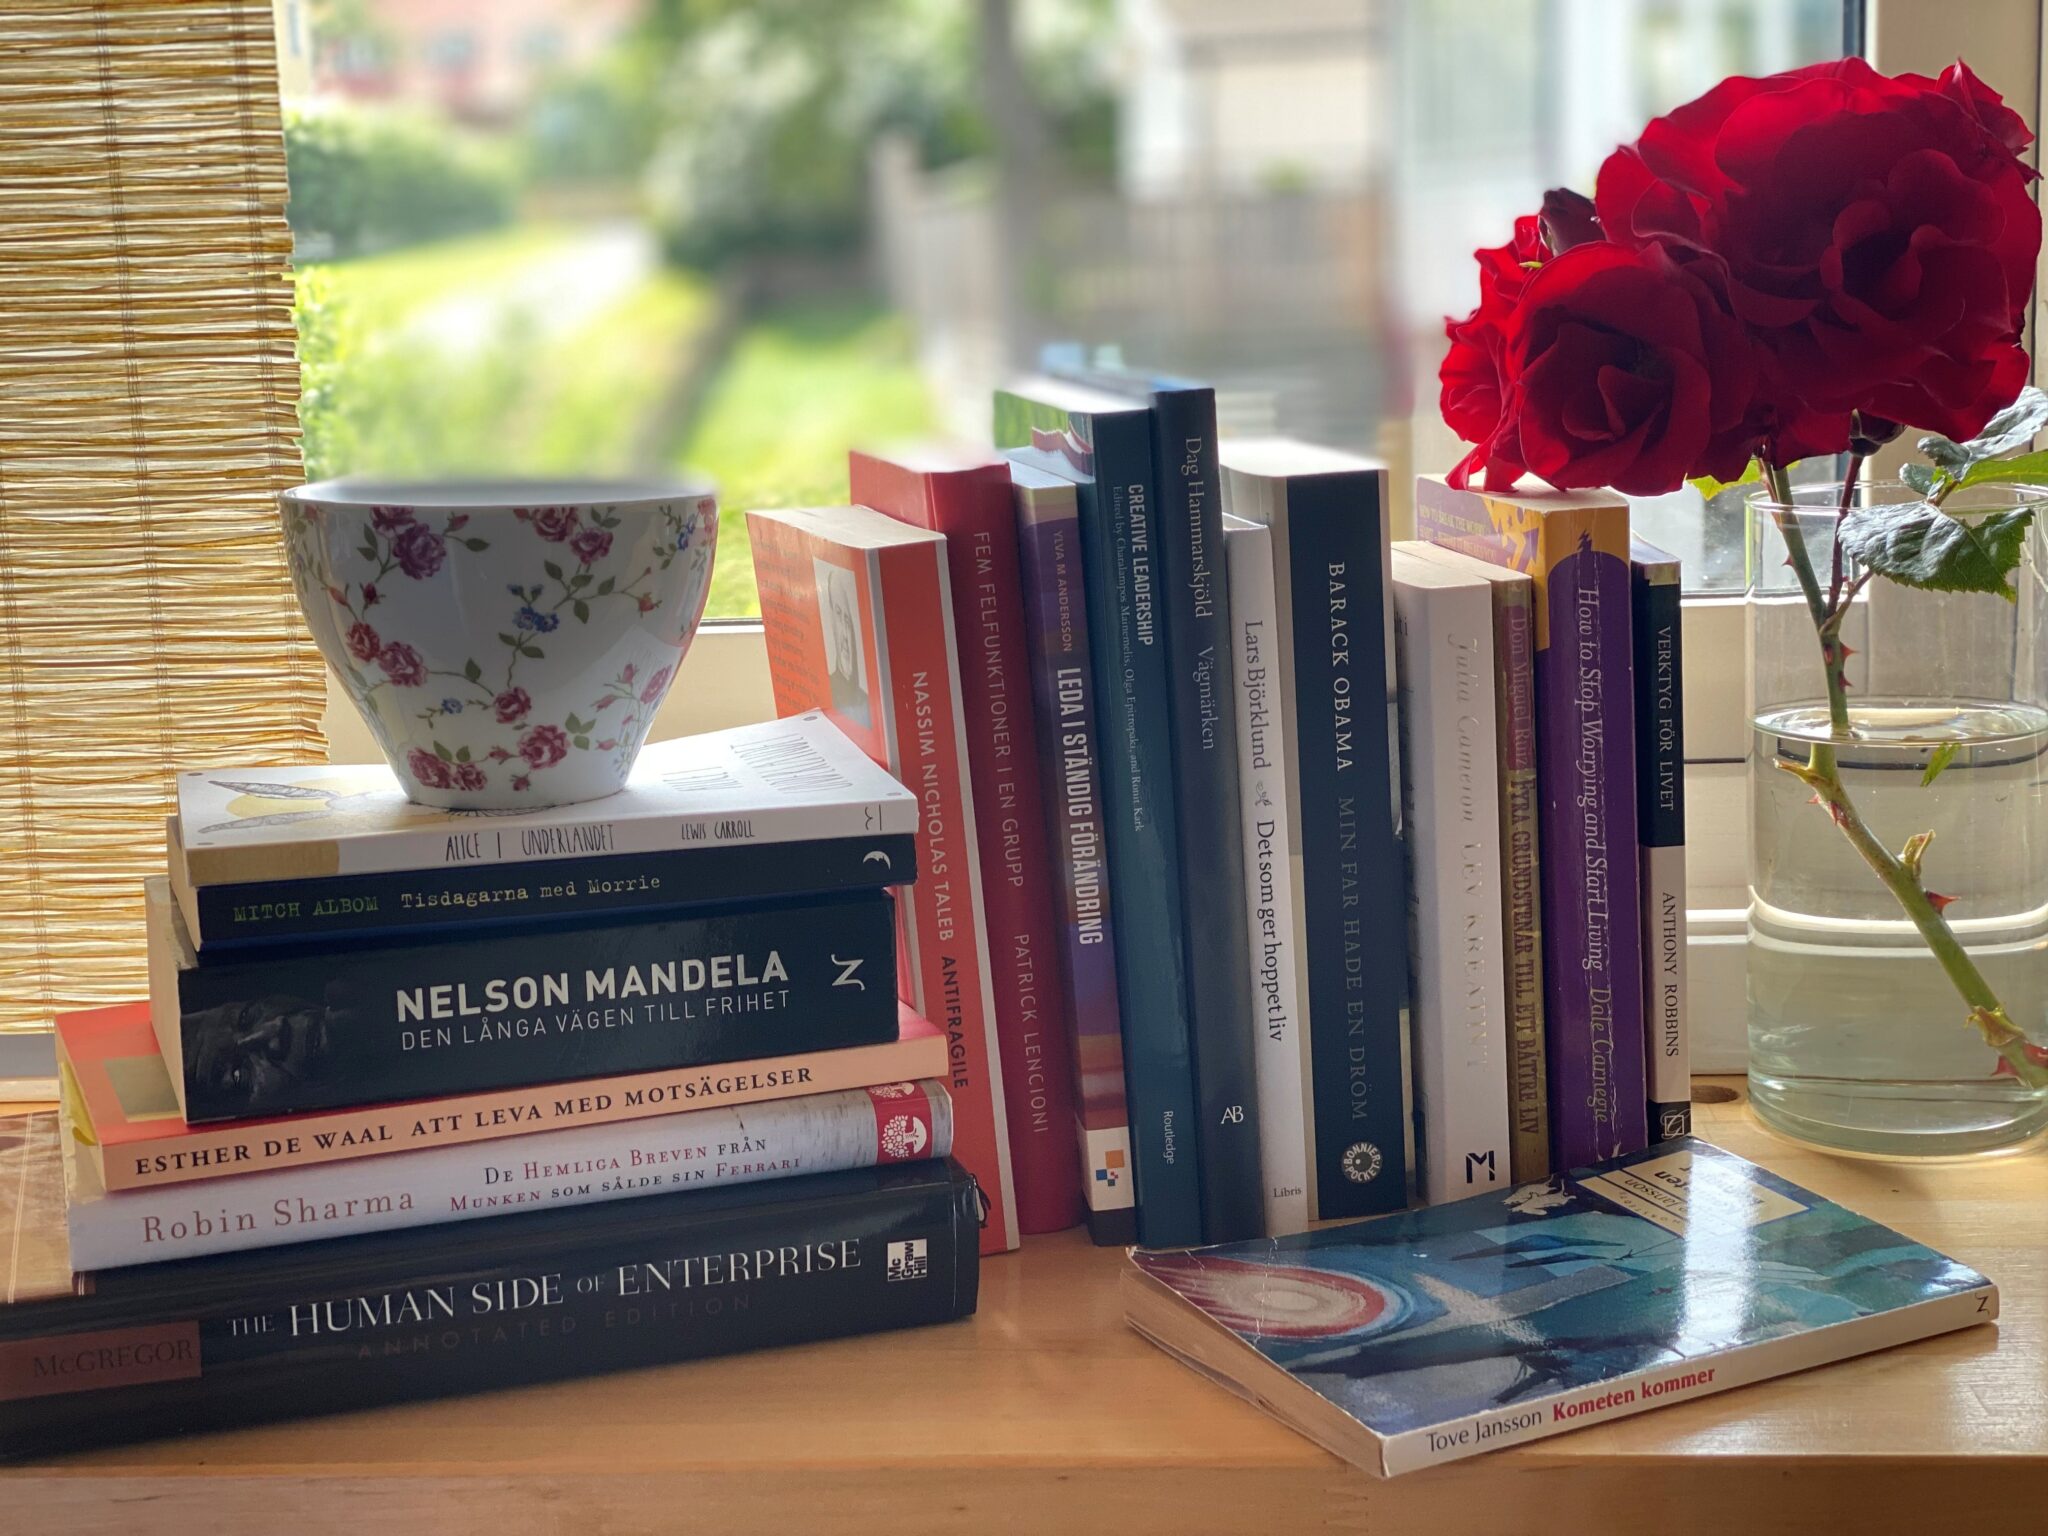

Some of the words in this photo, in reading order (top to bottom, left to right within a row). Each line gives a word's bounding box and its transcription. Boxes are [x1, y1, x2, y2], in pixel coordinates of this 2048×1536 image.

[1181, 437, 1202, 476] Dag
[1113, 521, 1124, 534] by
[1128, 484, 1147, 553] CREATIVE
[973, 532, 993, 575] FEM
[1053, 530, 1065, 561] YLVA
[1056, 563, 1066, 575] M
[1187, 481, 1213, 618] Hammarskjöld
[1057, 578, 1073, 652] ANDERSSON
[1132, 557, 1153, 646] LEADERSHIP
[1329, 562, 1349, 667] BARACK
[1578, 587, 1599, 635] How
[1245, 620, 1264, 664] Lars
[1509, 617, 1527, 654] Don
[1579, 640, 1597, 660] to
[979, 583, 1011, 758] FELFUNKTIONER
[1057, 667, 1085, 716] LEDA
[1122, 669, 1135, 694] Olga
[1508, 663, 1530, 723] Miguel
[1574, 667, 1601, 712] Stop
[1657, 626, 1672, 710] VERKTYG
[912, 671, 935, 757] NASSIM
[1193, 646, 1219, 750] Vägmärken
[1243, 667, 1272, 770] Björklund
[1333, 677, 1353, 772] OBAMA
[1514, 729, 1531, 771] Ruiz
[1659, 719, 1675, 752] FÖR
[1062, 733, 1093, 817] STÄNDIG
[1130, 755, 1141, 773] and
[1457, 715, 1480, 822] Cameron
[1576, 718, 1603, 809] Worrying
[1660, 761, 1674, 811] LIVET
[922, 764, 947, 875] NICHOLAS
[998, 782, 1017, 809] EN
[1134, 807, 1144, 832] Kark
[1510, 777, 1536, 826] FYRA
[446, 832, 482, 861] ALICE
[497, 832, 502, 858] I
[521, 824, 614, 856] UNDERLANDET
[681, 823, 706, 840] LEWIS
[714, 820, 755, 839] CARROLL
[1257, 820, 1275, 859] Det
[1338, 797, 1357, 851] MIN
[1585, 813, 1606, 850] and
[1002, 818, 1024, 887] GRUPP
[1462, 842, 1483, 898] LEV
[400, 887, 528, 911] Tisdagarna
[540, 882, 577, 898] med
[588, 874, 661, 894] Morrie
[1069, 821, 1104, 945] FÖRÄNDRING
[1259, 861, 1274, 903] som
[1342, 862, 1359, 909] FAR
[1511, 830, 1534, 956] GRUNDSTENAR
[1586, 856, 1607, 904] Start
[233, 902, 301, 922] MITCH
[312, 896, 379, 916] ALBOM
[934, 881, 954, 941] TALEB
[1256, 907, 1275, 939] ger
[1662, 892, 1677, 975] ANTHONY
[1344, 919, 1362, 990] HADE
[1582, 909, 1609, 971] Living
[397, 973, 569, 1022] NELSON
[585, 950, 789, 1002] MANDELA
[1014, 934, 1037, 1022] PATRICK
[1260, 940, 1283, 1013] hoppet
[1513, 959, 1535, 999] TILL
[402, 1028, 451, 1051] DEN
[463, 1017, 547, 1044] LÅNGA
[555, 1007, 634, 1033] VÄGEN
[644, 1001, 696, 1022] TILL
[706, 990, 790, 1016] FRIHET
[941, 955, 968, 1089] ANTIFRAGILE
[1268, 1014, 1287, 1041] liv
[1347, 1000, 1364, 1037] EN
[1515, 1004, 1537, 1033] ETT
[1590, 988, 1612, 1031] Dale
[1665, 983, 1679, 1057] ROBBINS
[1023, 1032, 1048, 1133] LENCIONI
[1349, 1047, 1372, 1120] DRÖM
[1517, 1039, 1541, 1103] BÄTTRE
[1587, 1040, 1614, 1123] Carnegie
[411, 1113, 463, 1137] ATT
[476, 1103, 543, 1127] LEVA
[554, 1094, 613, 1117] MED
[625, 1067, 814, 1107] MOTSÄGELSER
[1519, 1107, 1539, 1135] LIV
[135, 1144, 251, 1176] ESTHER
[264, 1137, 302, 1157] DE
[313, 1125, 393, 1150] WAAL
[1163, 1110, 1176, 1165] Routledge
[1343, 1143, 1380, 1165] BONNIER
[1272, 1187, 1302, 1198] Libris
[1345, 1163, 1380, 1182] POCKET
[142, 1209, 257, 1244] Robin
[274, 1192, 414, 1227] Sharma
[889, 1258, 901, 1280] Mc
[901, 1242, 914, 1279] Graw
[913, 1256, 926, 1277] Hill
[226, 1315, 275, 1337] THE
[289, 1286, 456, 1337] HUMAN
[471, 1273, 564, 1314] SIDE
[616, 1238, 862, 1296] ENTERPRISE
[357, 1316, 577, 1360] ANNOTATED
[605, 1294, 750, 1328] EDITION
[1426, 1429, 1470, 1452] Tove
[1474, 1409, 1542, 1442] Jansson
[1552, 1388, 1635, 1422] Kometen
[1641, 1367, 1715, 1400] kommer
